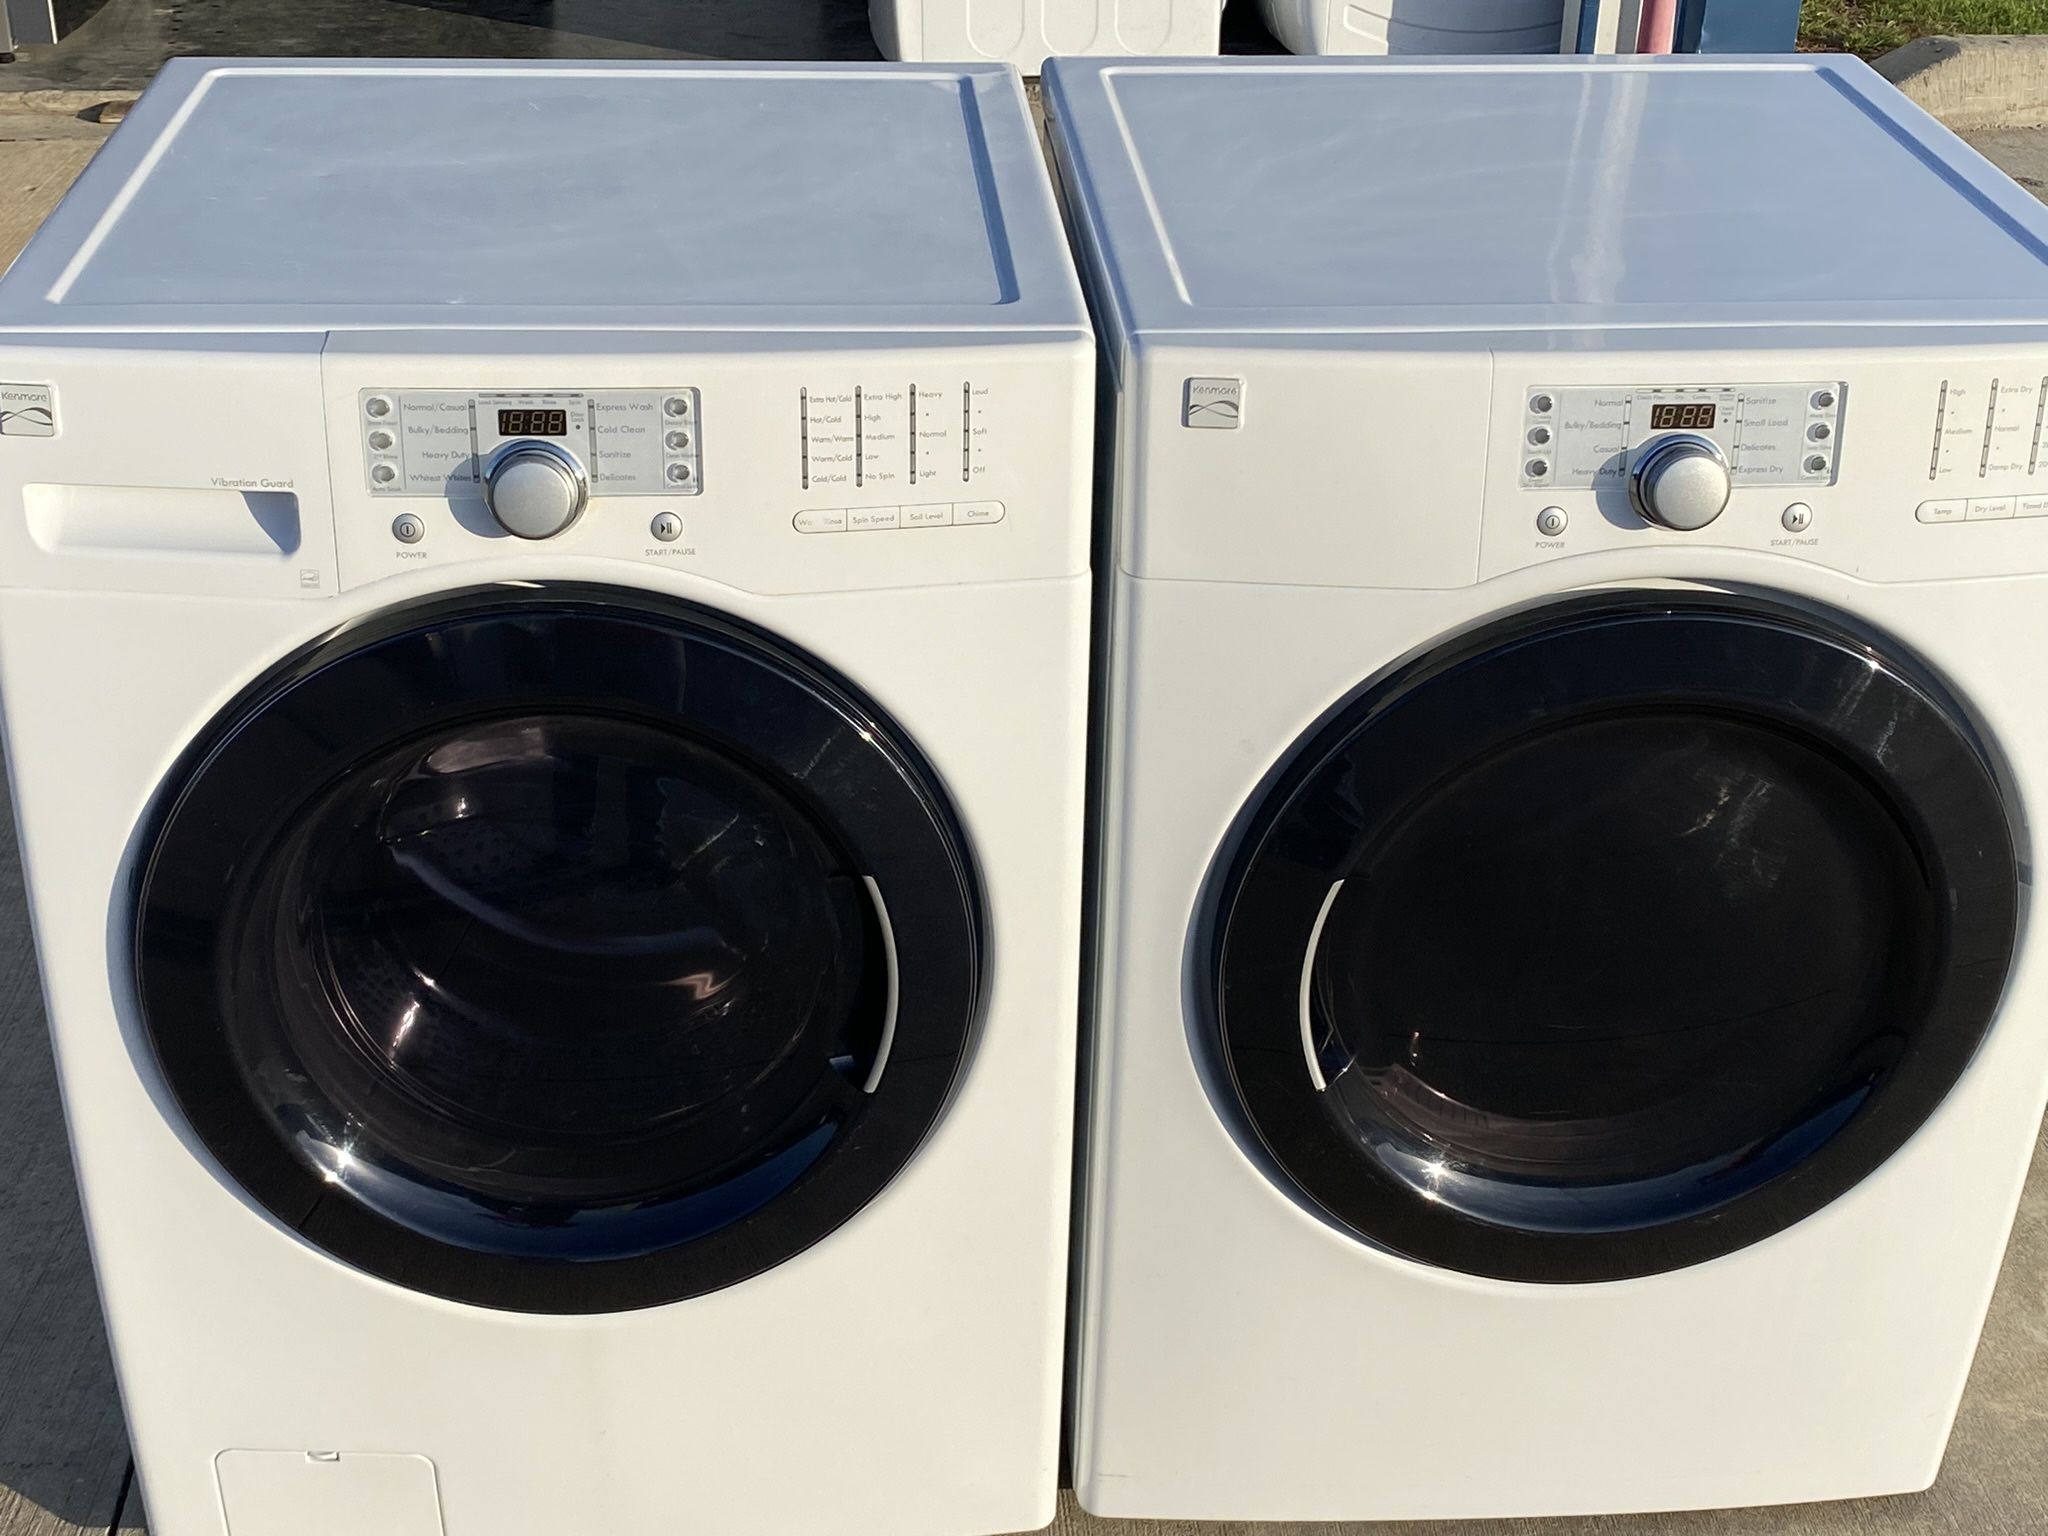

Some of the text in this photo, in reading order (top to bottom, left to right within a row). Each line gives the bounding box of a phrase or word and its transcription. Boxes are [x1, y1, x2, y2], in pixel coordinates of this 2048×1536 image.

[972, 388, 988, 396] Loud
[1193, 385, 1237, 395] Kenmore
[1950, 388, 1966, 397] High
[2000, 386, 2033, 395] Extra Dry
[1, 392, 48, 401] Kenmore
[826, 395, 852, 404] Hot/Cold
[864, 392, 902, 402] Extra High
[918, 391, 942, 400] Heavy
[1746, 397, 1776, 405] Sanitize
[404, 404, 467, 412] Normal/Casual
[596, 403, 626, 412] Express
[810, 416, 842, 424] Hot/Cold
[864, 413, 881, 423] High
[1744, 418, 1788, 427] Small Load
[598, 426, 646, 434] Cold Clean
[1564, 421, 1621, 430] Bulky/Bedding
[408, 426, 468, 435] Bulky/Bedding
[919, 430, 947, 438] Normal
[972, 428, 988, 436] Soft
[865, 433, 895, 441] Medium
[1593, 445, 1620, 453] Casual
[1740, 444, 1776, 452] Delicates
[422, 451, 470, 460] Heavy Duty
[812, 454, 852, 464] Warm/Cold
[972, 466, 986, 474] Off
[1600, 468, 1616, 477] Duty
[1738, 465, 1784, 474] Express Dry
[1988, 464, 2023, 472] Damp Dry
[878, 472, 895, 482] Spin
[919, 470, 936, 478] Light
[210, 478, 294, 488] Vibration Guard
[812, 474, 847, 484] Cold/Cold
[1934, 508, 1952, 516] Temp
[1975, 504, 2006, 514] Dry Level
[852, 515, 895, 525] Spin Speed
[925, 512, 944, 520] Level
[645, 548, 696, 556] START/PAUSE
